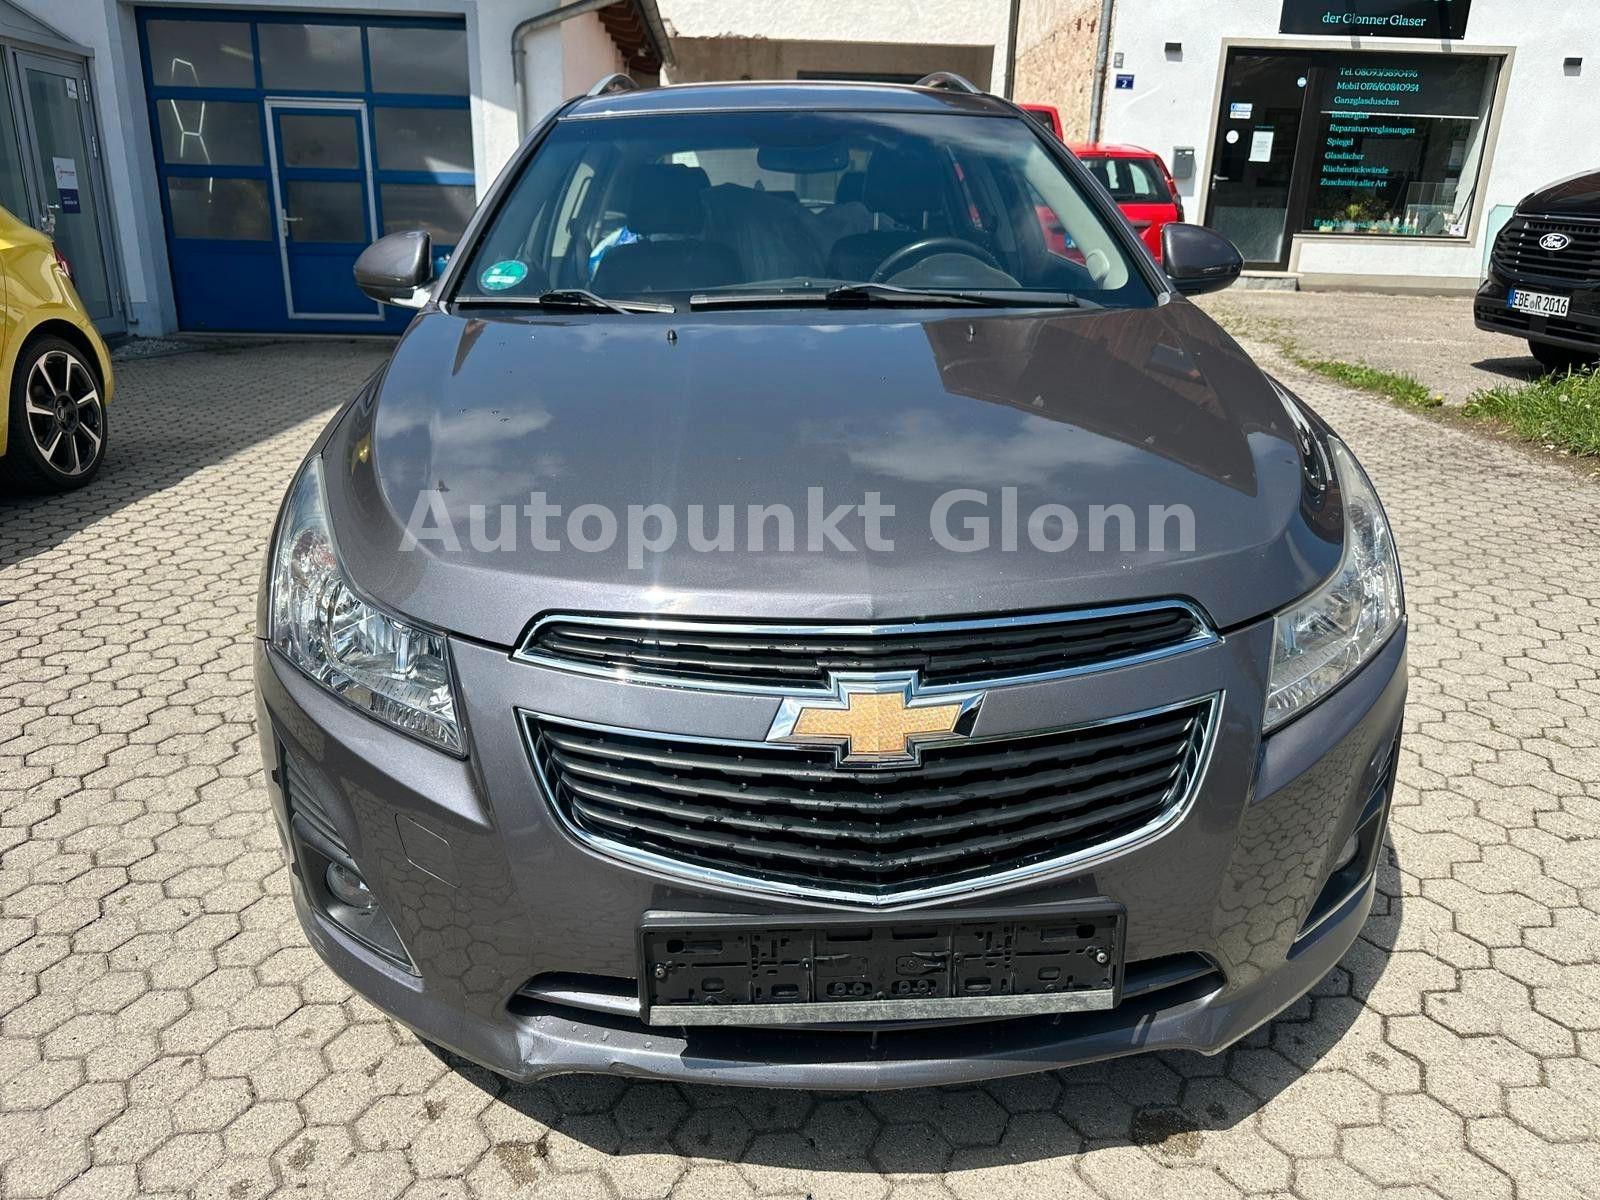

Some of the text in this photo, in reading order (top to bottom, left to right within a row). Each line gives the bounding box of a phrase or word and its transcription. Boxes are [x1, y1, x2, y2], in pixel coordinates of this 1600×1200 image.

[1322, 12, 1426, 26] der Glonner Glaser
[1121, 80, 1128, 88] 2
[1336, 81, 1420, 92] Mobil 0176/60840954
[1333, 96, 1400, 106] Ganzglasduschen
[1329, 123, 1416, 135] Reparaturverglasungen
[1326, 137, 1354, 148] Spiegel
[1324, 151, 1365, 161] Glasdächer
[1322, 164, 1389, 175] Küchenrückwände
[1320, 178, 1387, 188] Zuschnitte aller Art
[1542, 235, 1565, 249] Ford
[1514, 292, 1529, 307] EBE
[1543, 297, 1567, 314] 2016
